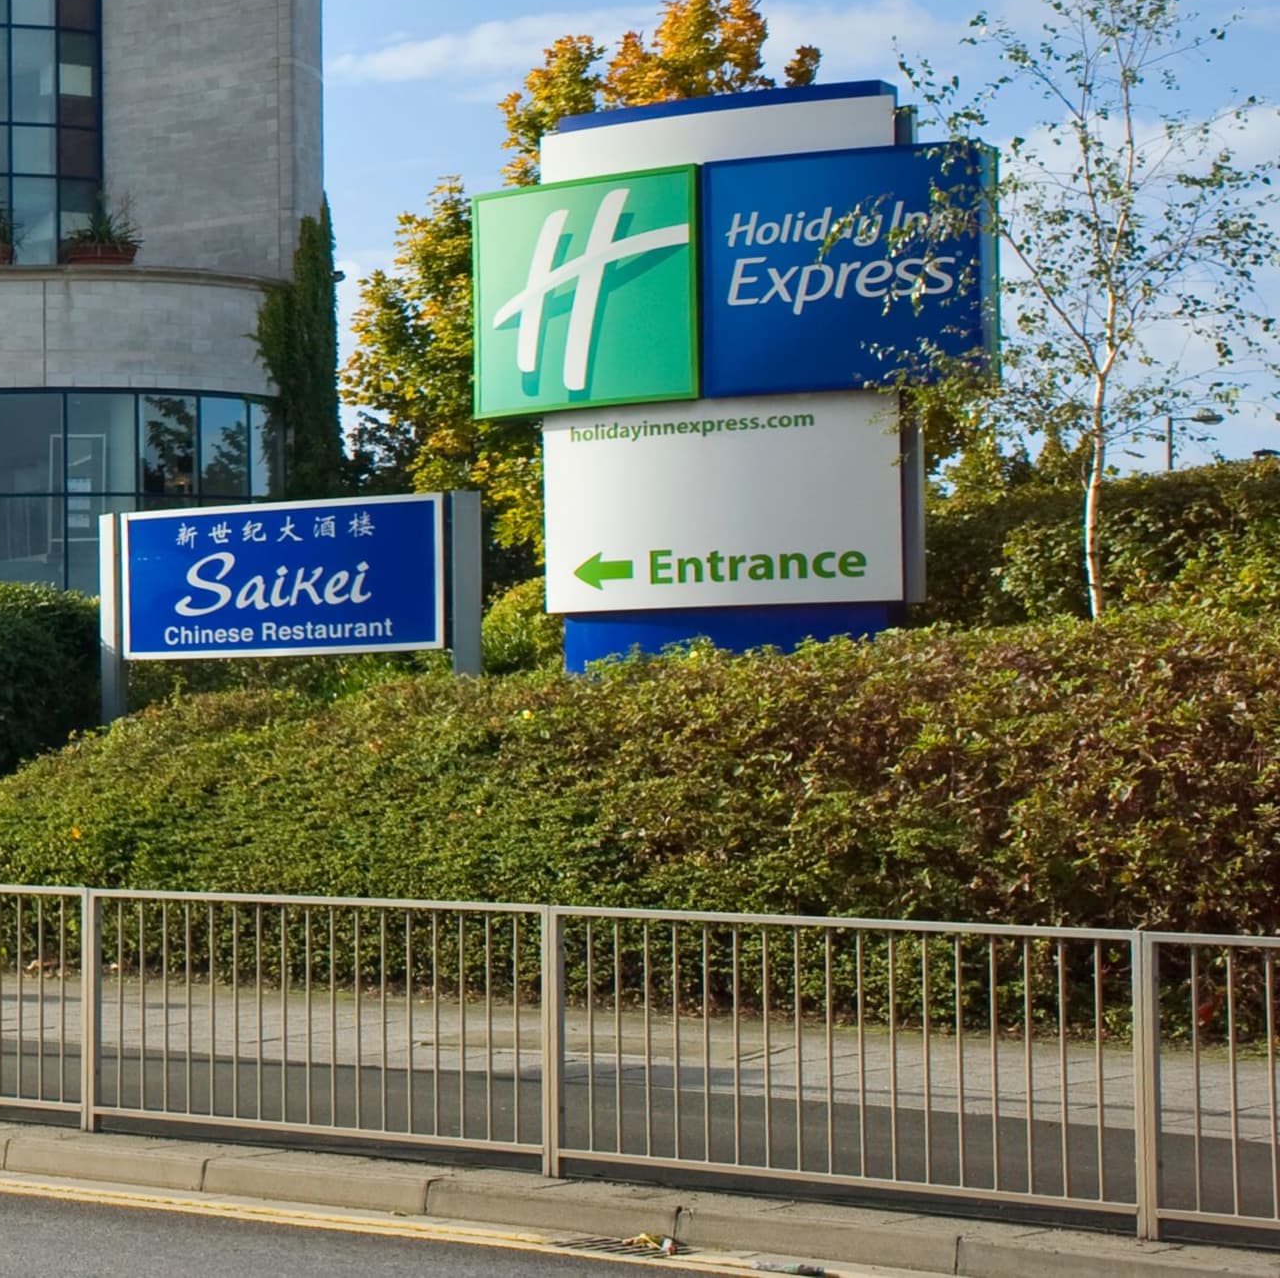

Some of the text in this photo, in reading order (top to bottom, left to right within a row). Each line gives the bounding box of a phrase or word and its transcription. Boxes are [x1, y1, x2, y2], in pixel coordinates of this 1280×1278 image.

[492, 188, 689, 391] H
[727, 256, 956, 315] Express
[570, 412, 815, 443] holidayinnexpress.com
[175, 510, 377, 550] 新世纪大酒楼
[649, 547, 867, 585] Entrance
[164, 618, 393, 645] Chinese Restaurant
